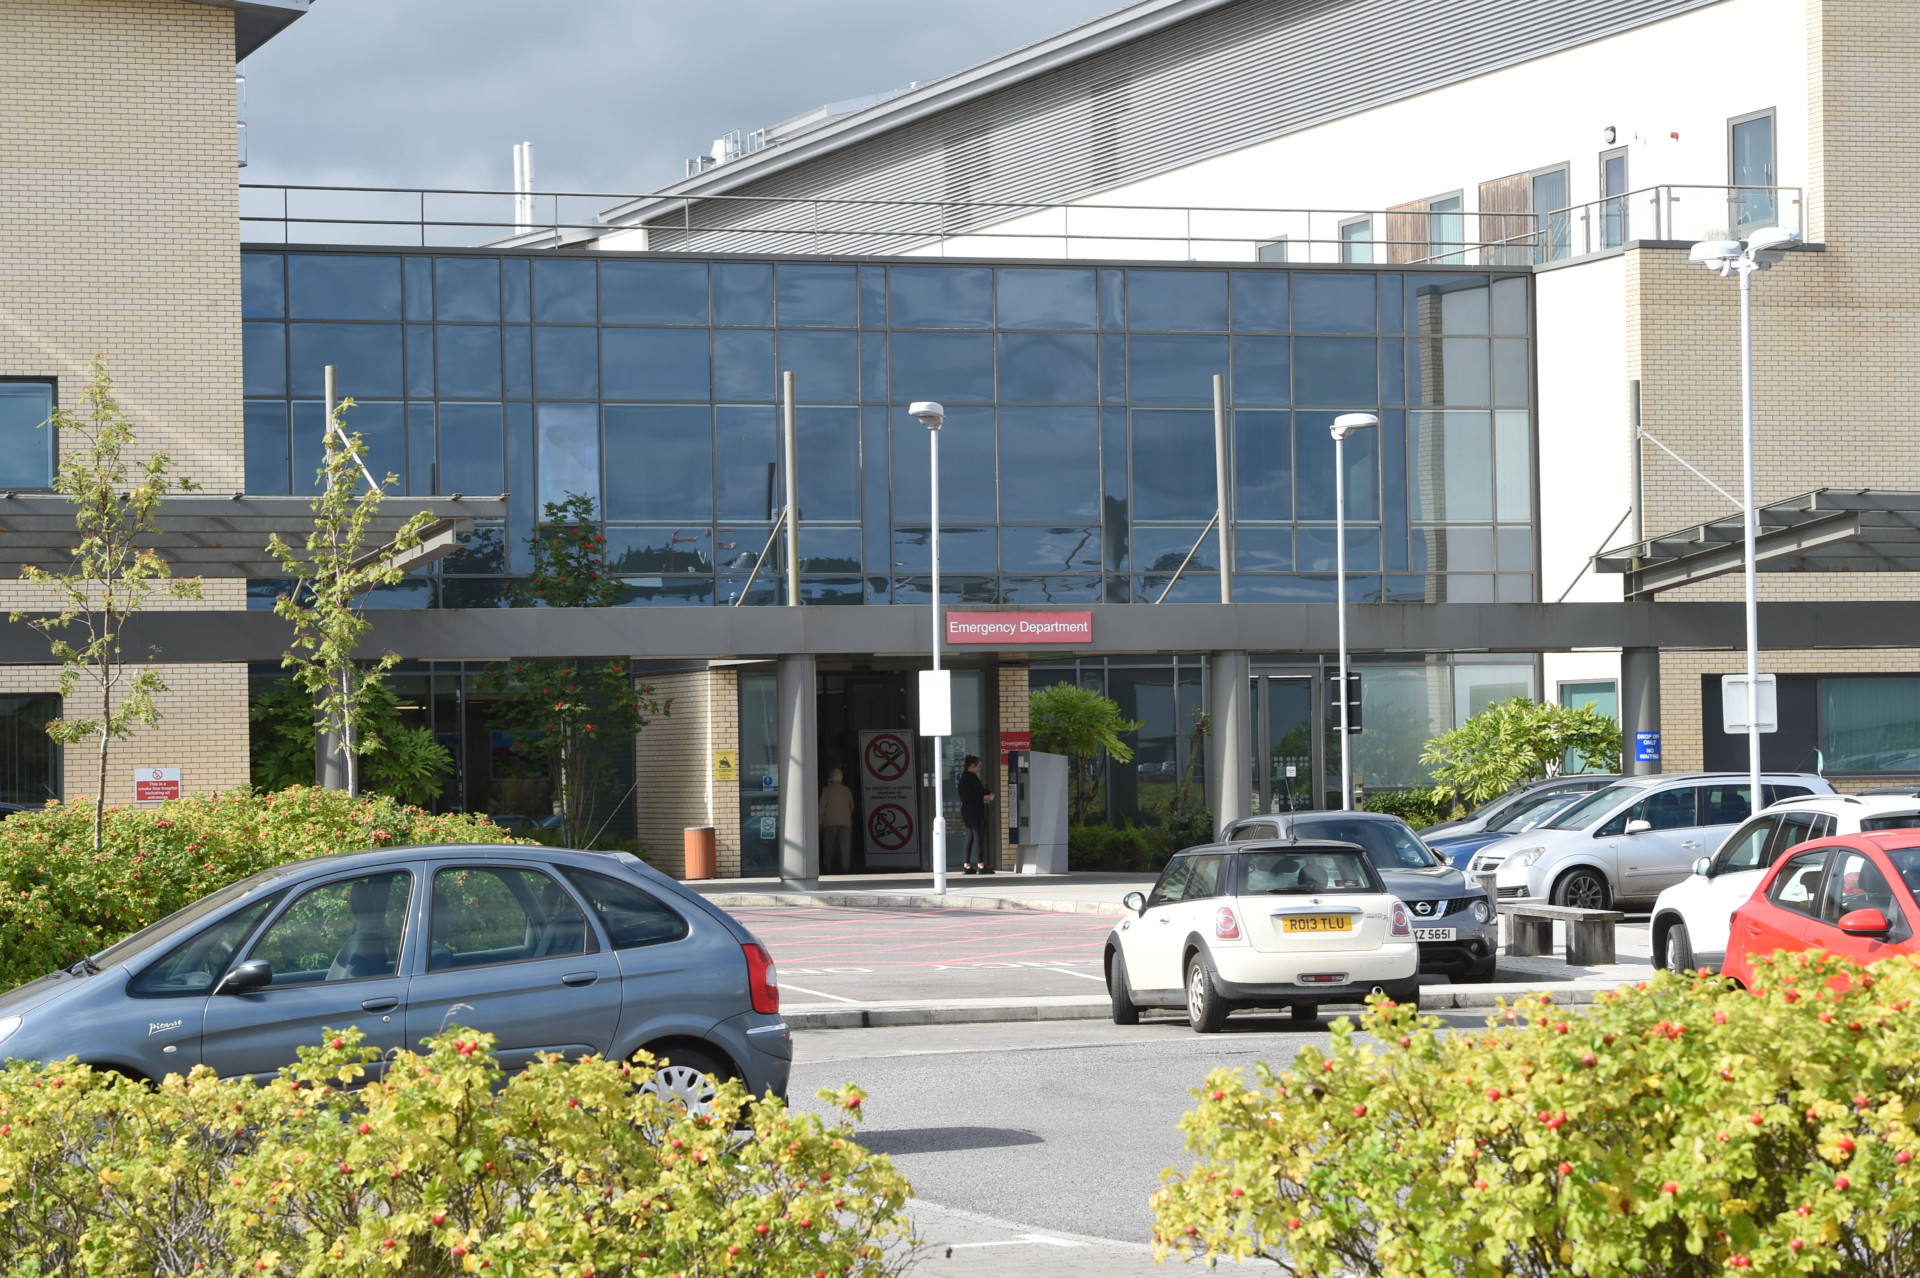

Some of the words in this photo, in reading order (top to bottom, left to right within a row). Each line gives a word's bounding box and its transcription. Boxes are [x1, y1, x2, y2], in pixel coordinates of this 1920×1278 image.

[949, 621, 1016, 636] Emergency
[1019, 620, 1089, 635] Department
[1290, 918, 1317, 930] RO13
[1320, 917, 1345, 929] TLU
[1428, 929, 1450, 939] 5651
[148, 1019, 183, 1036] Picasso
